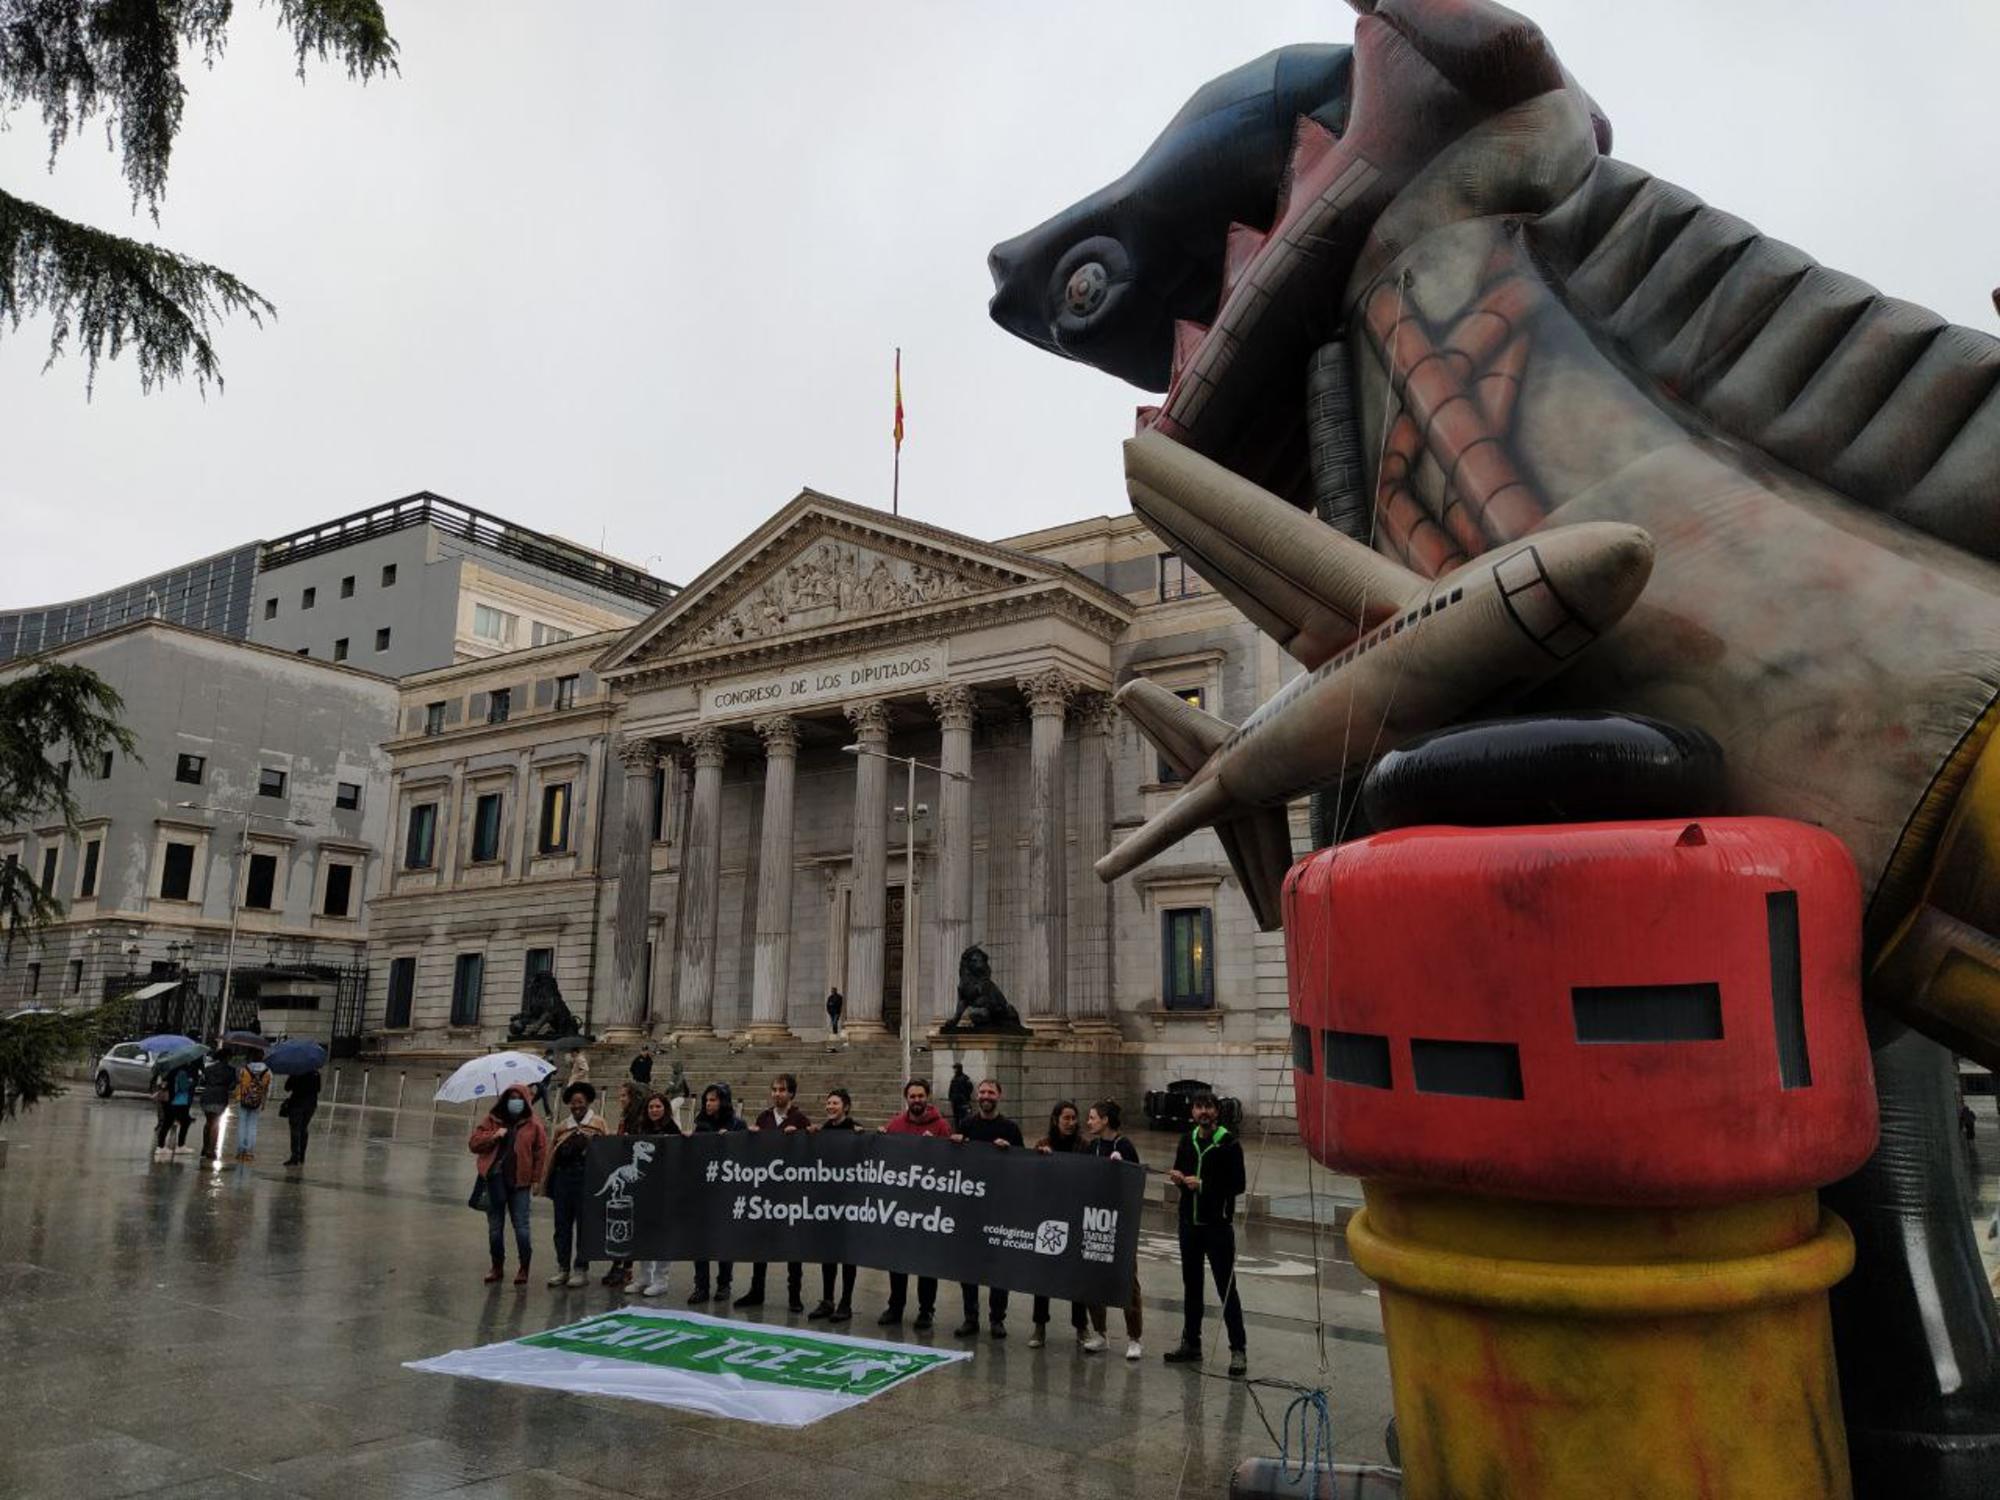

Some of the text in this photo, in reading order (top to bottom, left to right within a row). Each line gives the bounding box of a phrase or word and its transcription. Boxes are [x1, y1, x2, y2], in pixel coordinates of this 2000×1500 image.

[714, 657, 932, 709] CONGRESO DE LOS DIPUTADOS
[705, 1158, 987, 1198] #StopCombustiblesFósiles
[732, 1196, 956, 1234] #StopLavadoVerde
[1082, 1205, 1119, 1233] NO!
[982, 1224, 1035, 1240] ecologistas
[988, 1236, 1034, 1250] en acción
[553, 1319, 710, 1351] EXIT
